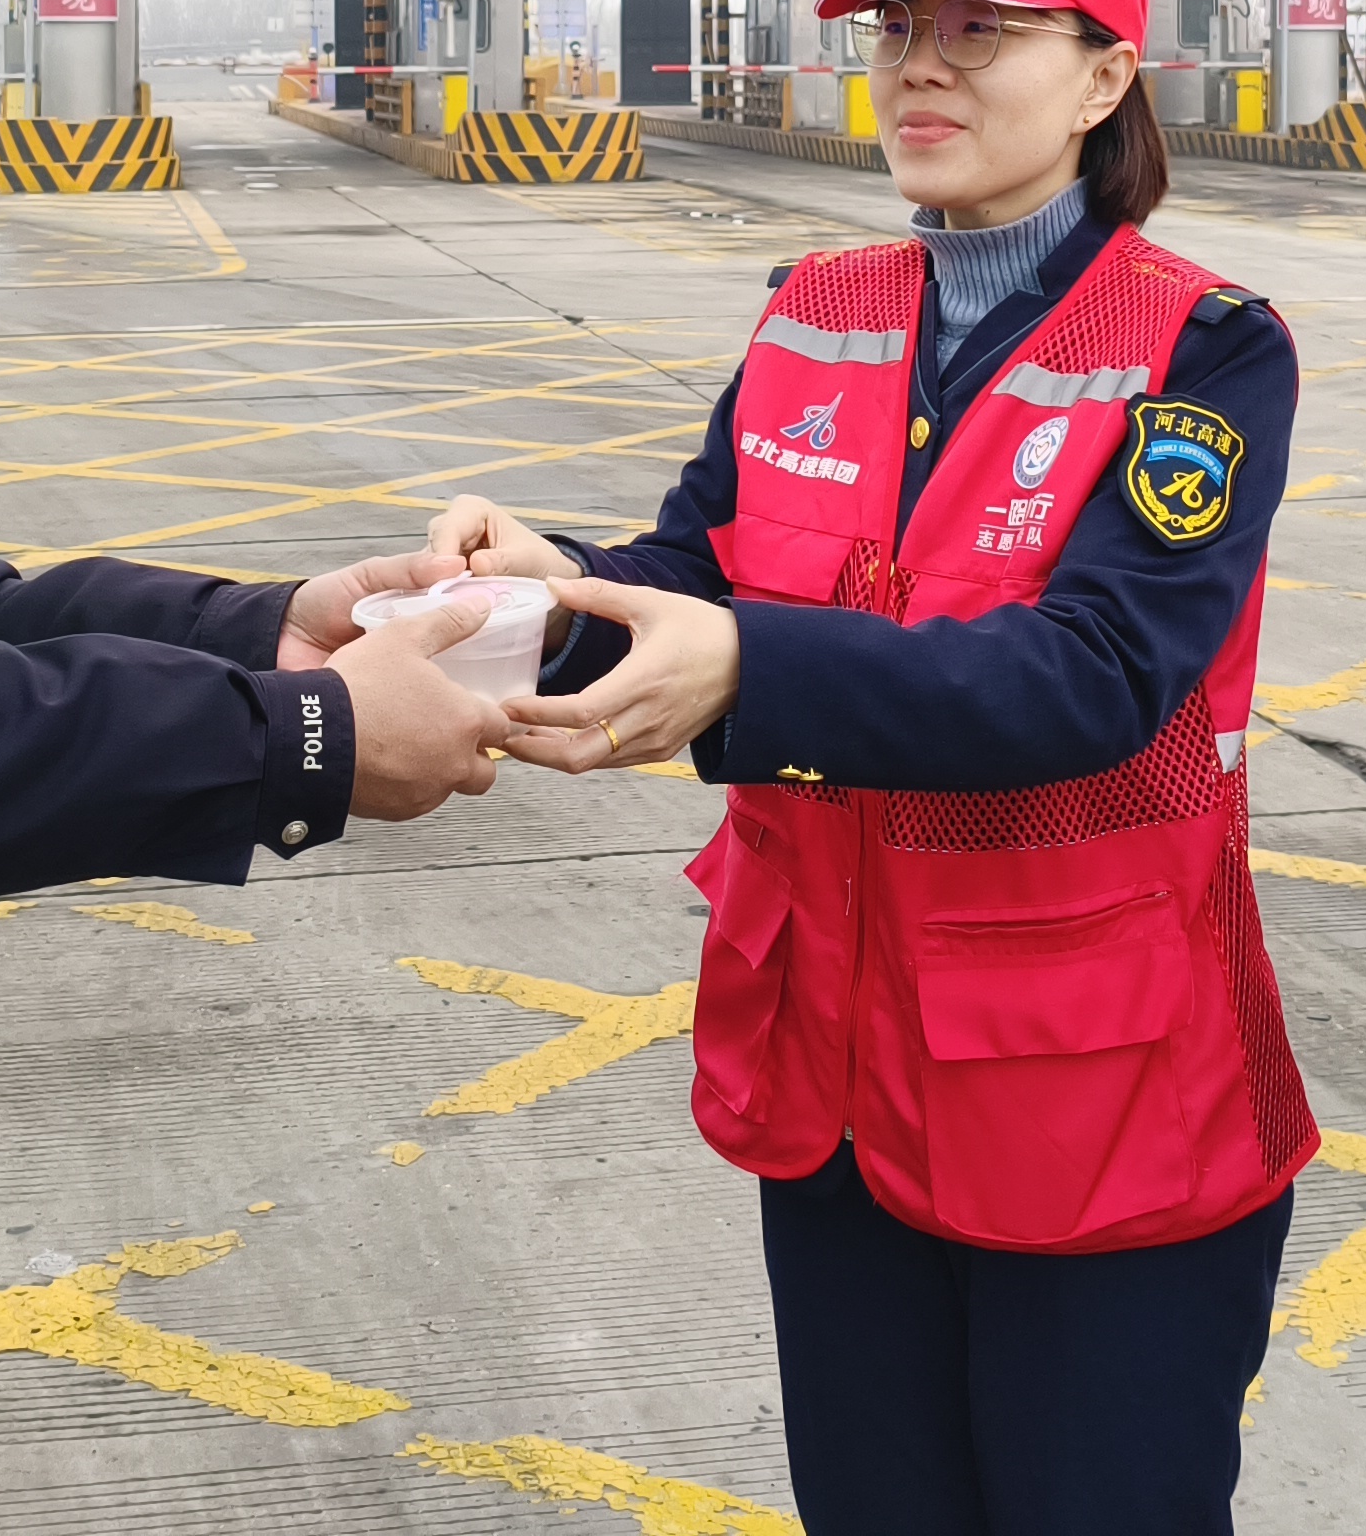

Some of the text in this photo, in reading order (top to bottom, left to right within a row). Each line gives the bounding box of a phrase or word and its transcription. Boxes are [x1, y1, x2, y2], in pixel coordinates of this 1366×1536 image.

[740, 431, 861, 485] 河北高速集团
[1154, 410, 1233, 456] 河北高速
[985, 493, 1055, 526] 一路行
[300, 694, 323, 770] POLICE
